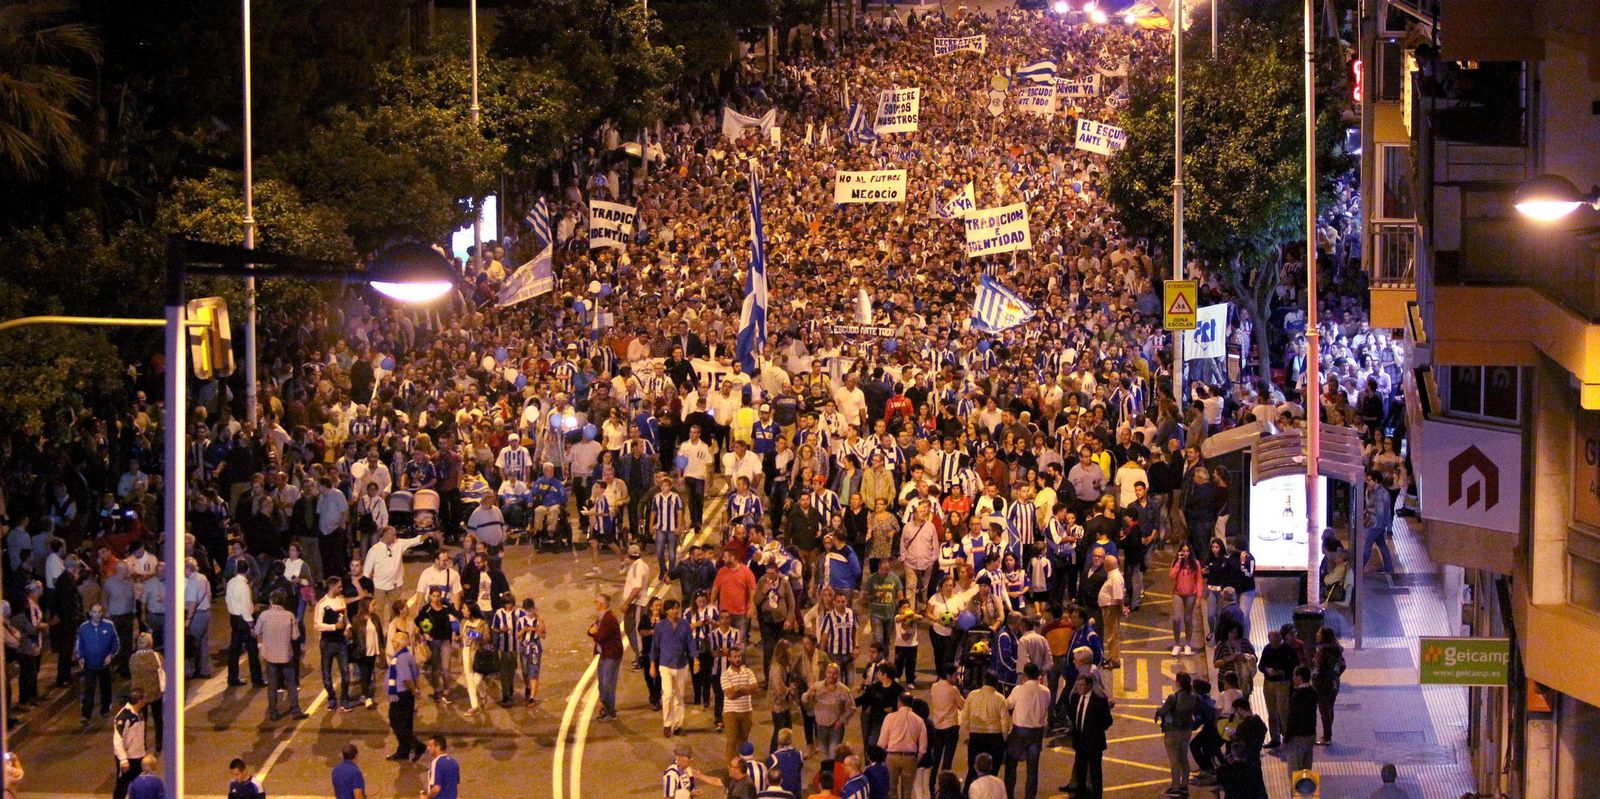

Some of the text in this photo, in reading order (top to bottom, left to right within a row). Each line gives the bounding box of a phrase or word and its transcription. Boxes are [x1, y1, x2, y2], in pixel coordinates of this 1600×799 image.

[892, 91, 916, 103] RECRE
[1081, 121, 1091, 132] EL
[1079, 133, 1102, 146] ANTE
[839, 174, 901, 184] NO AL FUTBOL
[592, 207, 634, 225] TRADIC
[965, 209, 1024, 231] TRADICION
[994, 227, 1001, 236] E
[967, 230, 1025, 253] IDENTIDAD
[860, 326, 877, 336] ANTE
[878, 327, 895, 337] TODO
[1111, 657, 1197, 701] US
[1432, 669, 1501, 678] www.geicamp.es
